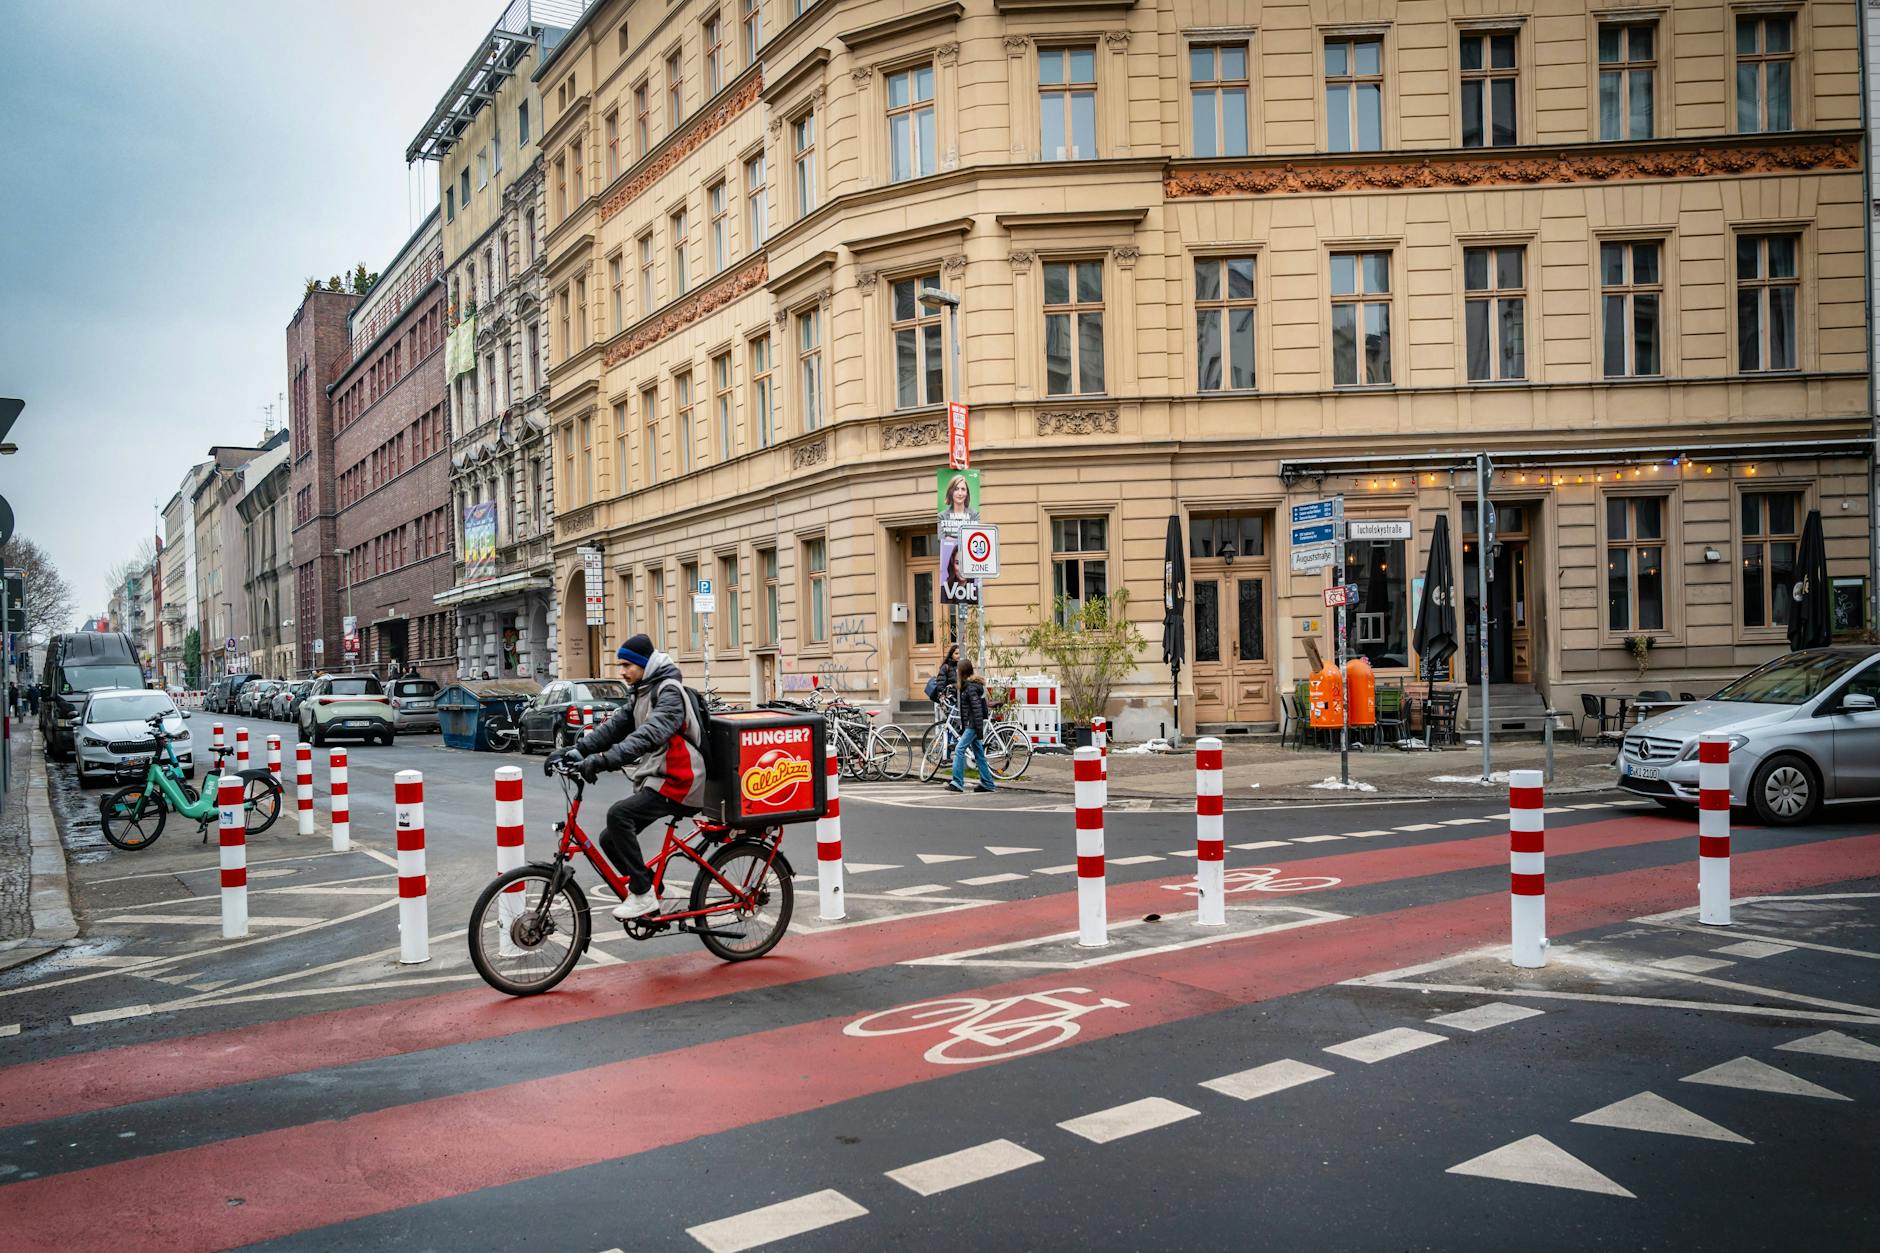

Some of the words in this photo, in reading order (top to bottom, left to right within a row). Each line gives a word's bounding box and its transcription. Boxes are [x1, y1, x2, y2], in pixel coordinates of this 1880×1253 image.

[1356, 524, 1403, 536] Tucholskystraße
[1296, 550, 1332, 565] Auguststraße
[971, 564, 989, 572] ZONE
[943, 581, 978, 601] Volt
[741, 728, 811, 746] HUNGER?
